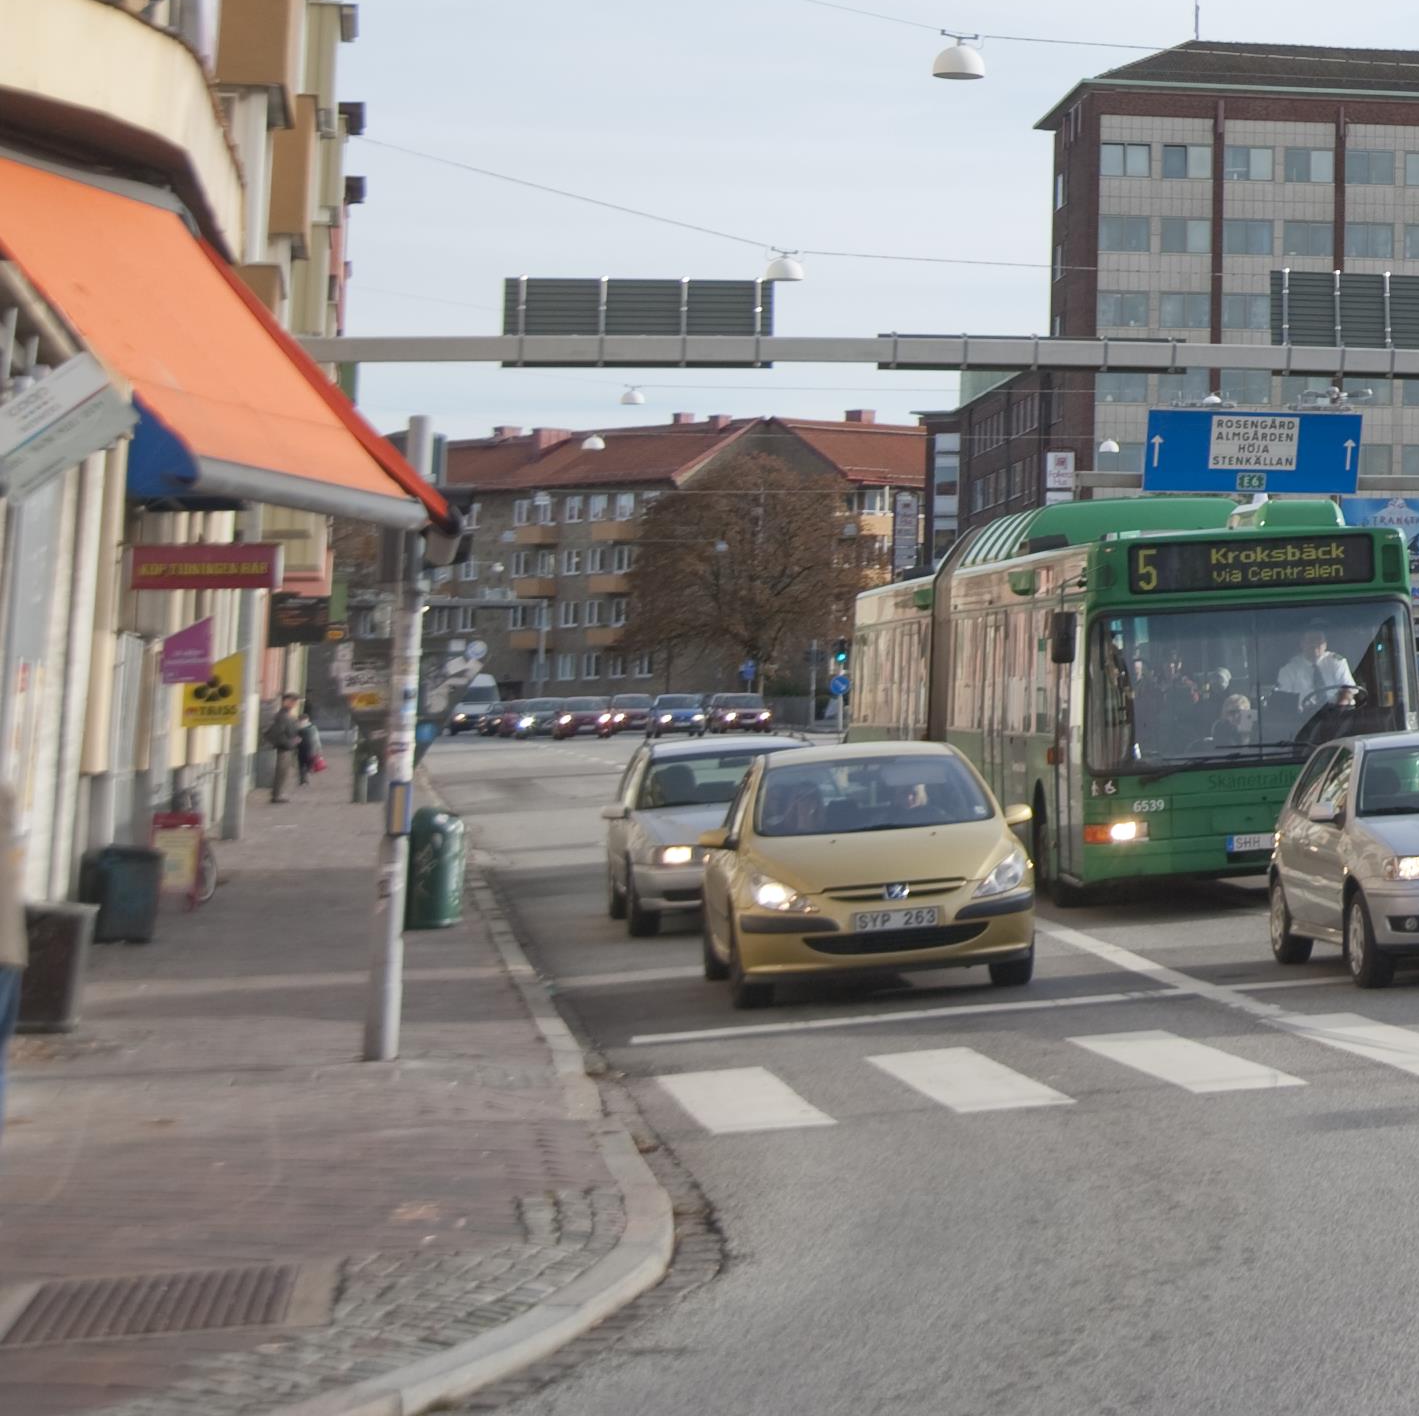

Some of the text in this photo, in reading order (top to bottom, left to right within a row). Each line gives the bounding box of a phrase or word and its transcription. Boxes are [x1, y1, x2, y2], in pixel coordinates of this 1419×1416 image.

[1216, 418, 1296, 430] ROSENGÅRD
[1215, 431, 1294, 443] ALMGÅRDEN
[1237, 442, 1270, 454] HÖJA
[1212, 455, 1293, 467] STENKÄLLAN
[1243, 476, 1260, 487] E6
[1138, 542, 1345, 591] 5 Kroksbäck
[1212, 563, 1344, 583] via Centralen
[201, 704, 239, 716] TRISS
[1133, 799, 1165, 812] 6539
[1235, 836, 1261, 849] SHH
[858, 909, 936, 929] SYP 263
